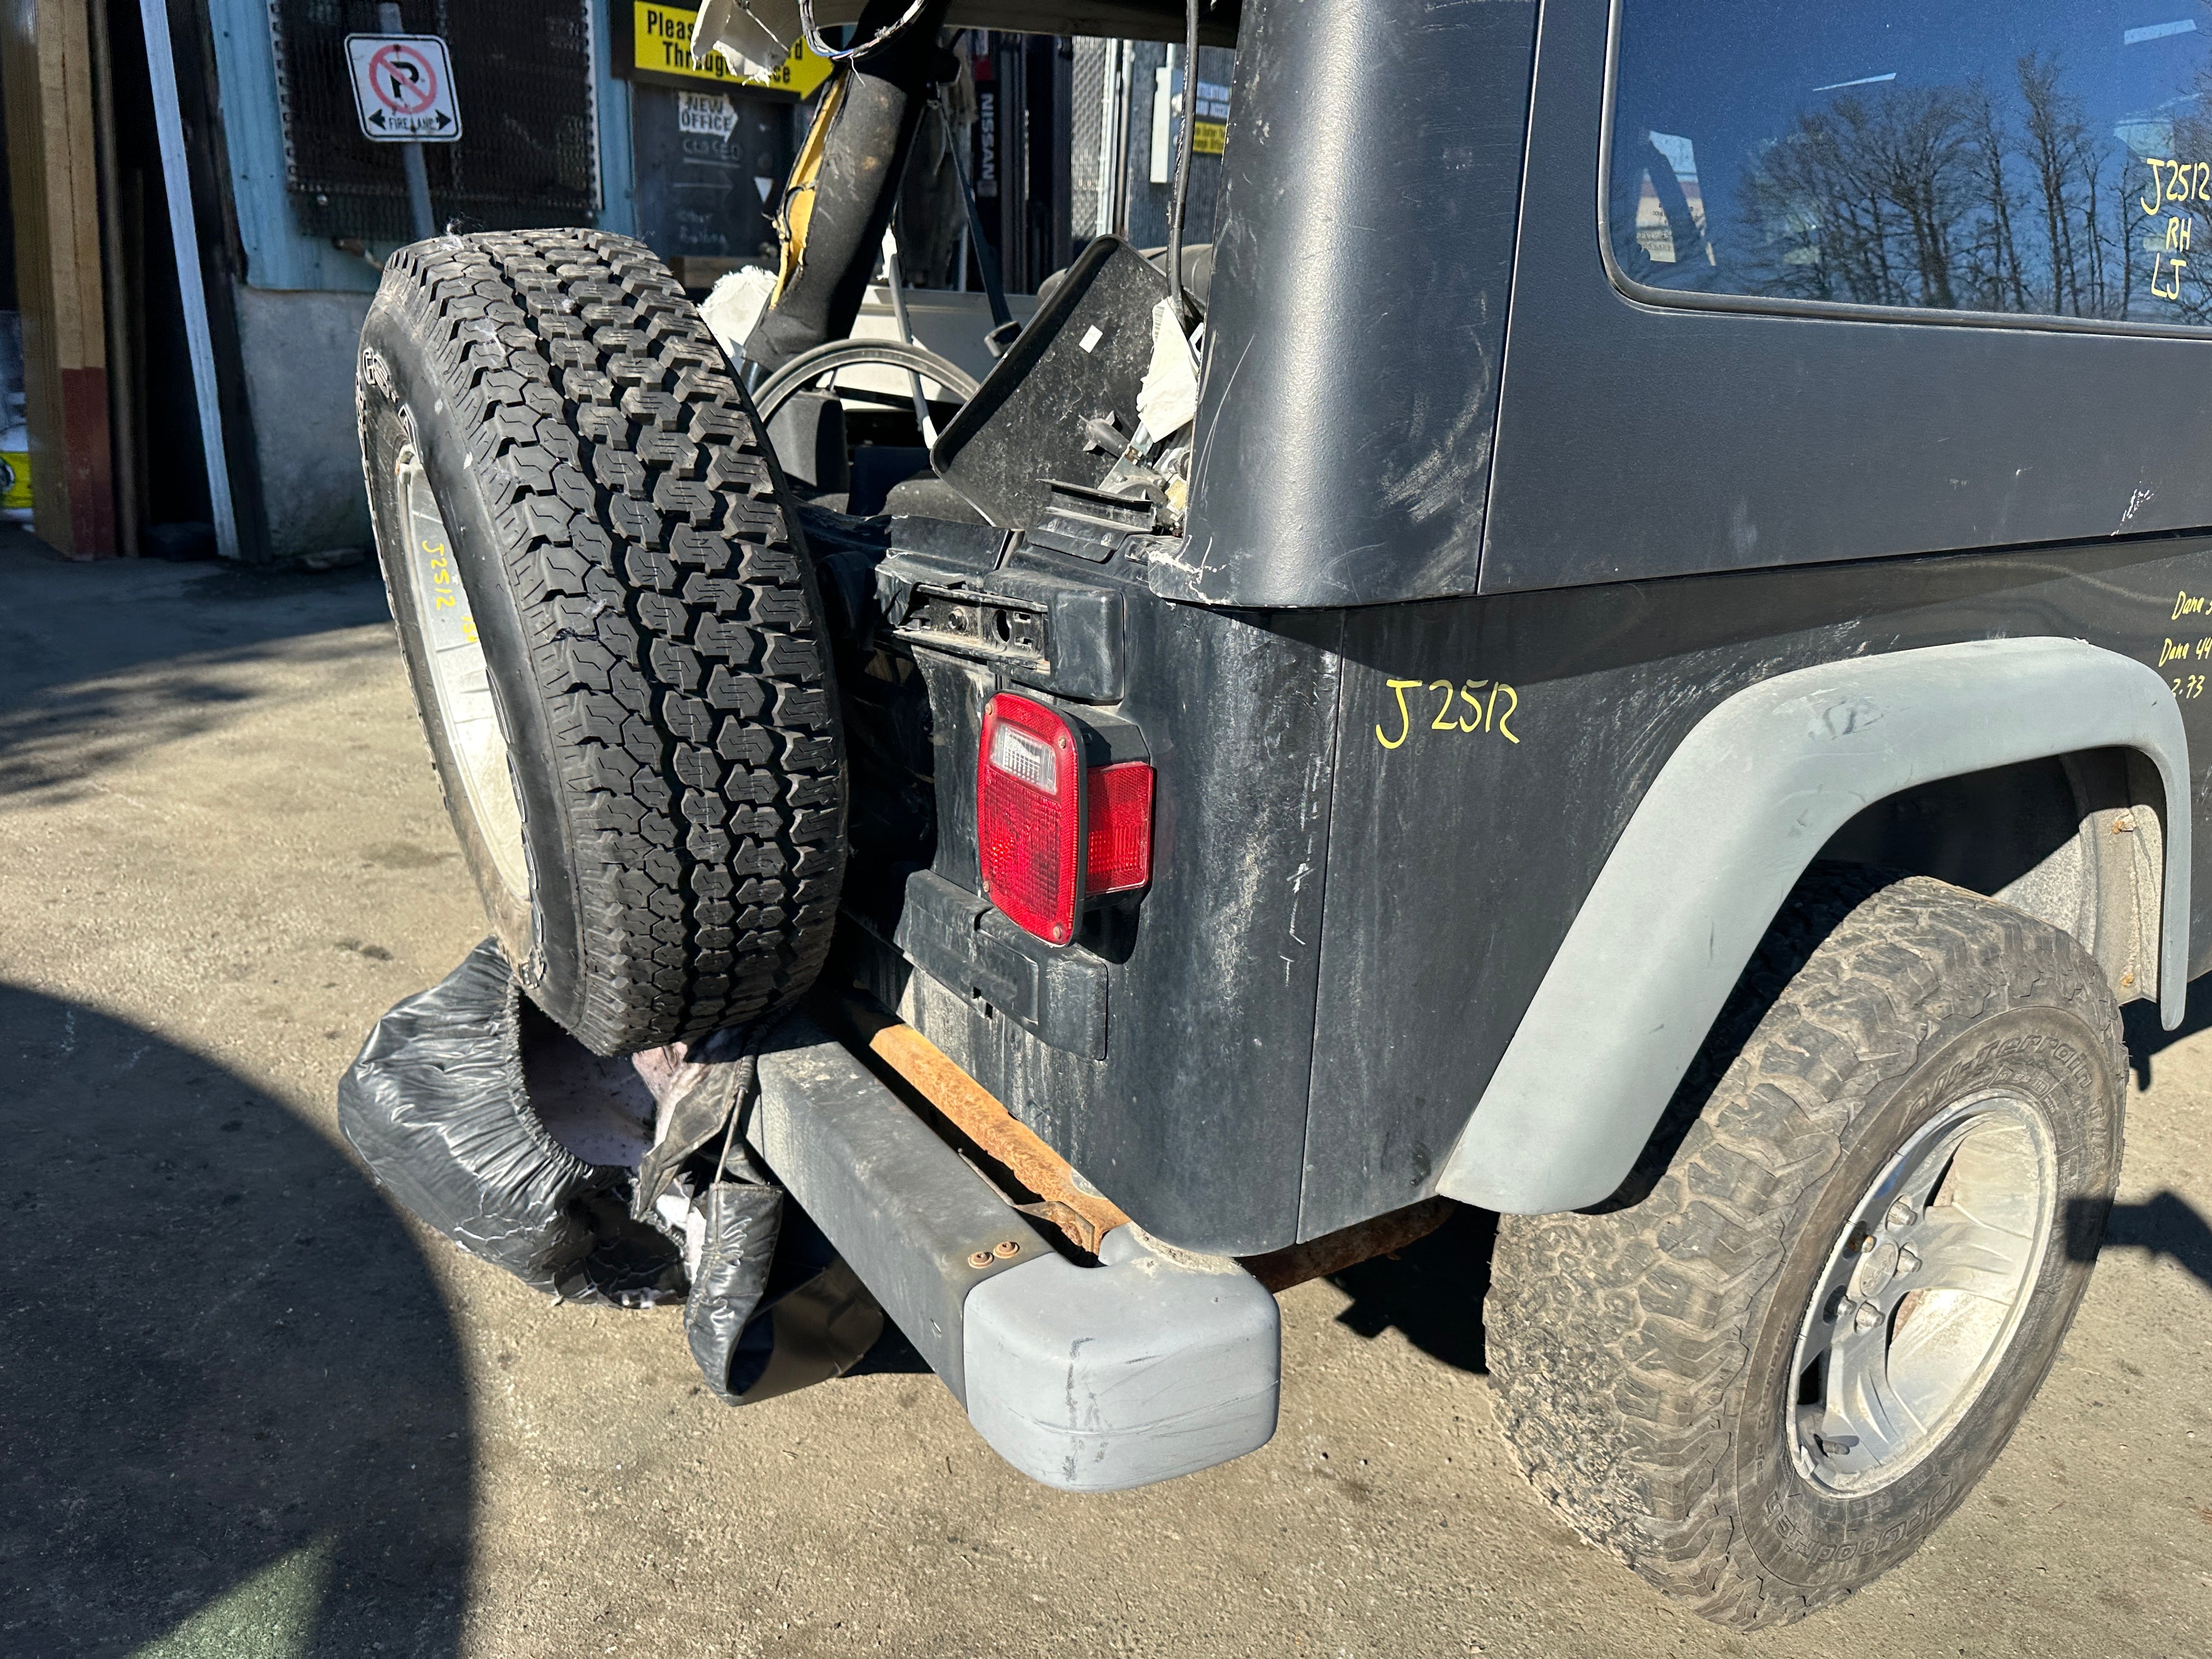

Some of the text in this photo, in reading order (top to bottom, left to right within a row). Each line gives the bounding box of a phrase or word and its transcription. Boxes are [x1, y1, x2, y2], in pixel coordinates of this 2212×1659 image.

[647, 10, 694, 41] Pleas
[681, 109, 733, 132] OFFICE
[686, 94, 724, 113] NEW
[388, 117, 409, 130] FIRE
[980, 93, 995, 181] NISSAN
[2141, 158, 2211, 215] J2512
[2165, 217, 2192, 252] RH
[2151, 252, 2187, 300] LJ
[422, 540, 456, 611] J2512
[2171, 590, 2205, 620] Dana
[2158, 637, 2212, 667] Dana 44
[1896, 1033, 2093, 1137] All-Terrain
[1763, 1479, 1953, 1563] BFGoodrich
